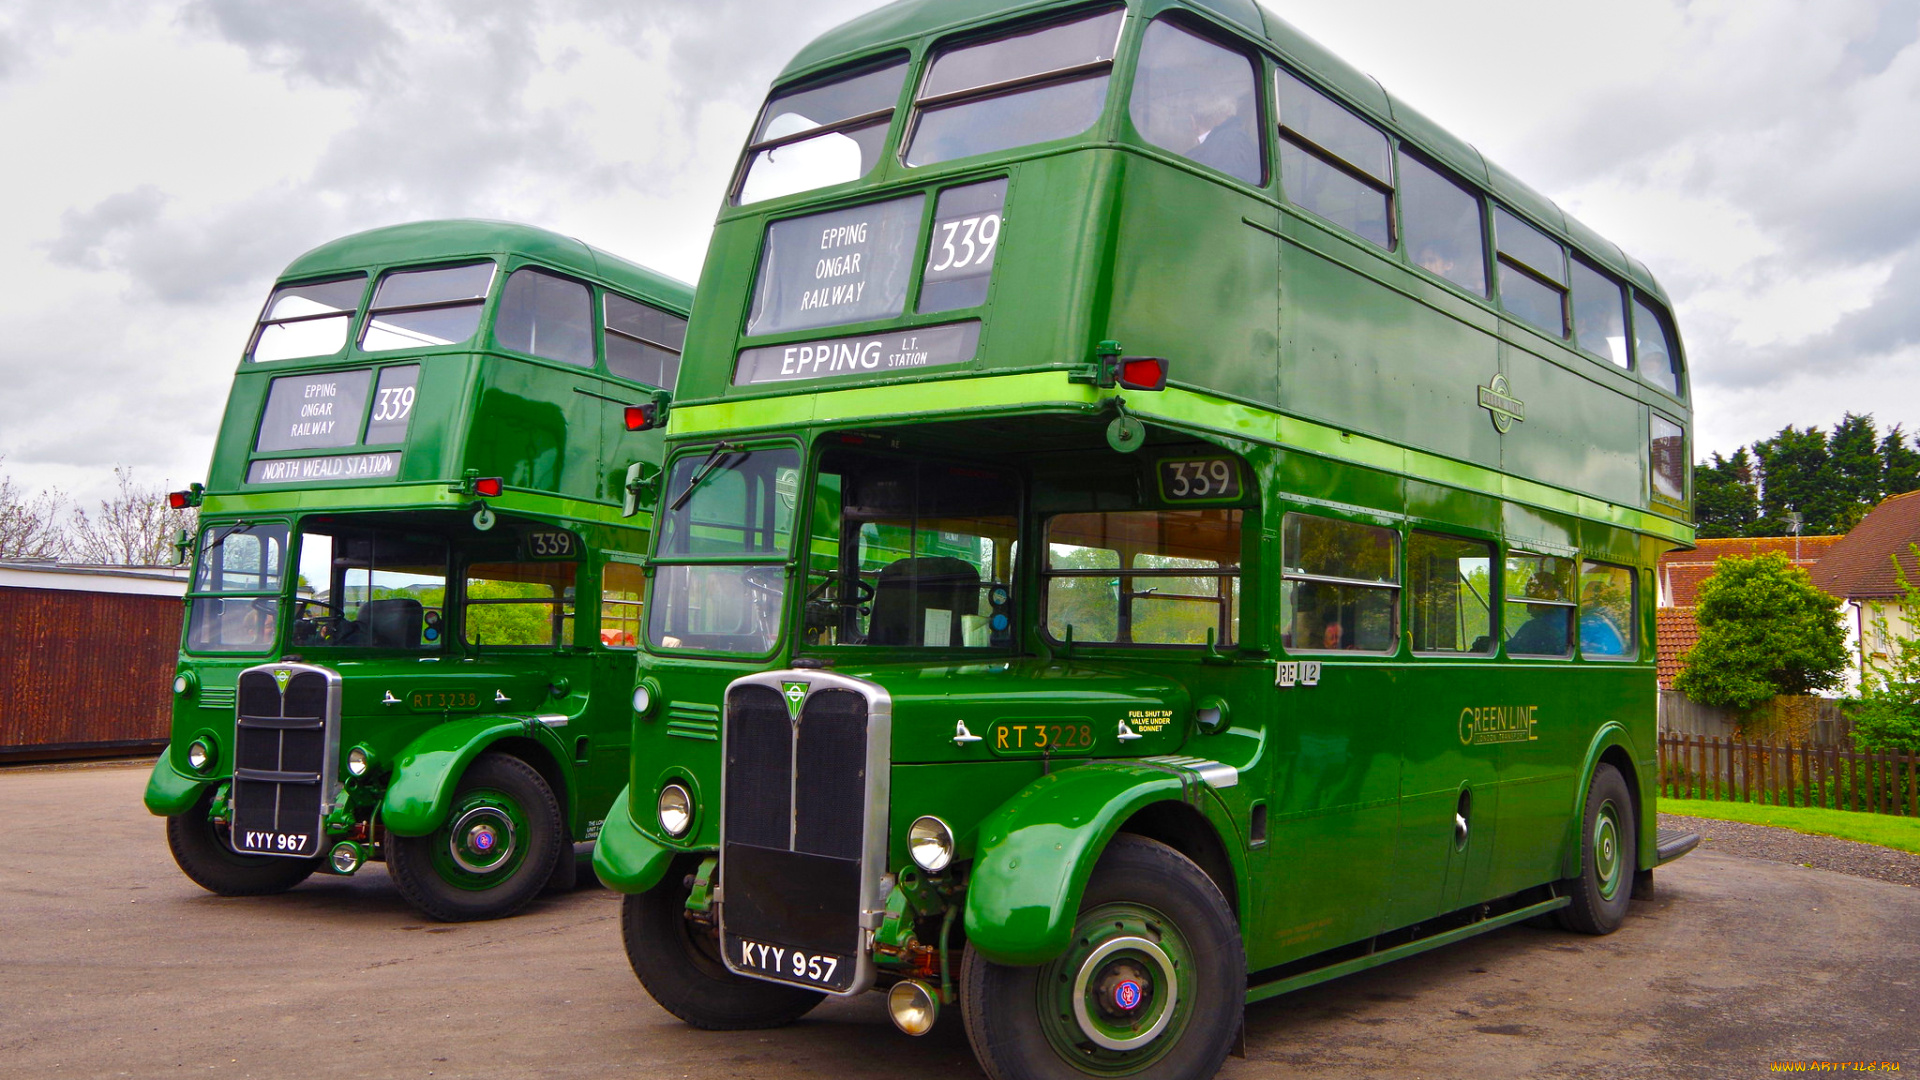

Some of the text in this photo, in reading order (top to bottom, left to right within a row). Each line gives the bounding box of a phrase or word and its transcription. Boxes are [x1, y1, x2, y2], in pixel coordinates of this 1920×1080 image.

[820, 222, 868, 250] EPPING
[932, 214, 1000, 272] 339
[815, 253, 861, 279] ONGAR
[800, 281, 866, 311] RAILWAY
[901, 337, 919, 351] L.T.
[780, 341, 928, 375] EPPING STATION
[304, 383, 337, 398] EPPING
[301, 403, 333, 417] ONGAR
[373, 386, 416, 421] 339
[291, 421, 335, 437] RAILWAY
[262, 455, 393, 480] NORTH WEALD STATION
[1169, 460, 1230, 496] 339
[533, 533, 570, 554] 339
[1279, 664, 1317, 682] RE 12
[414, 693, 477, 707] RT 3238
[997, 725, 1092, 749] RT 3228
[1459, 705, 1538, 745] GREEN LINE
[246, 831, 308, 851] KYY 967
[742, 940, 838, 982] KYY 957
